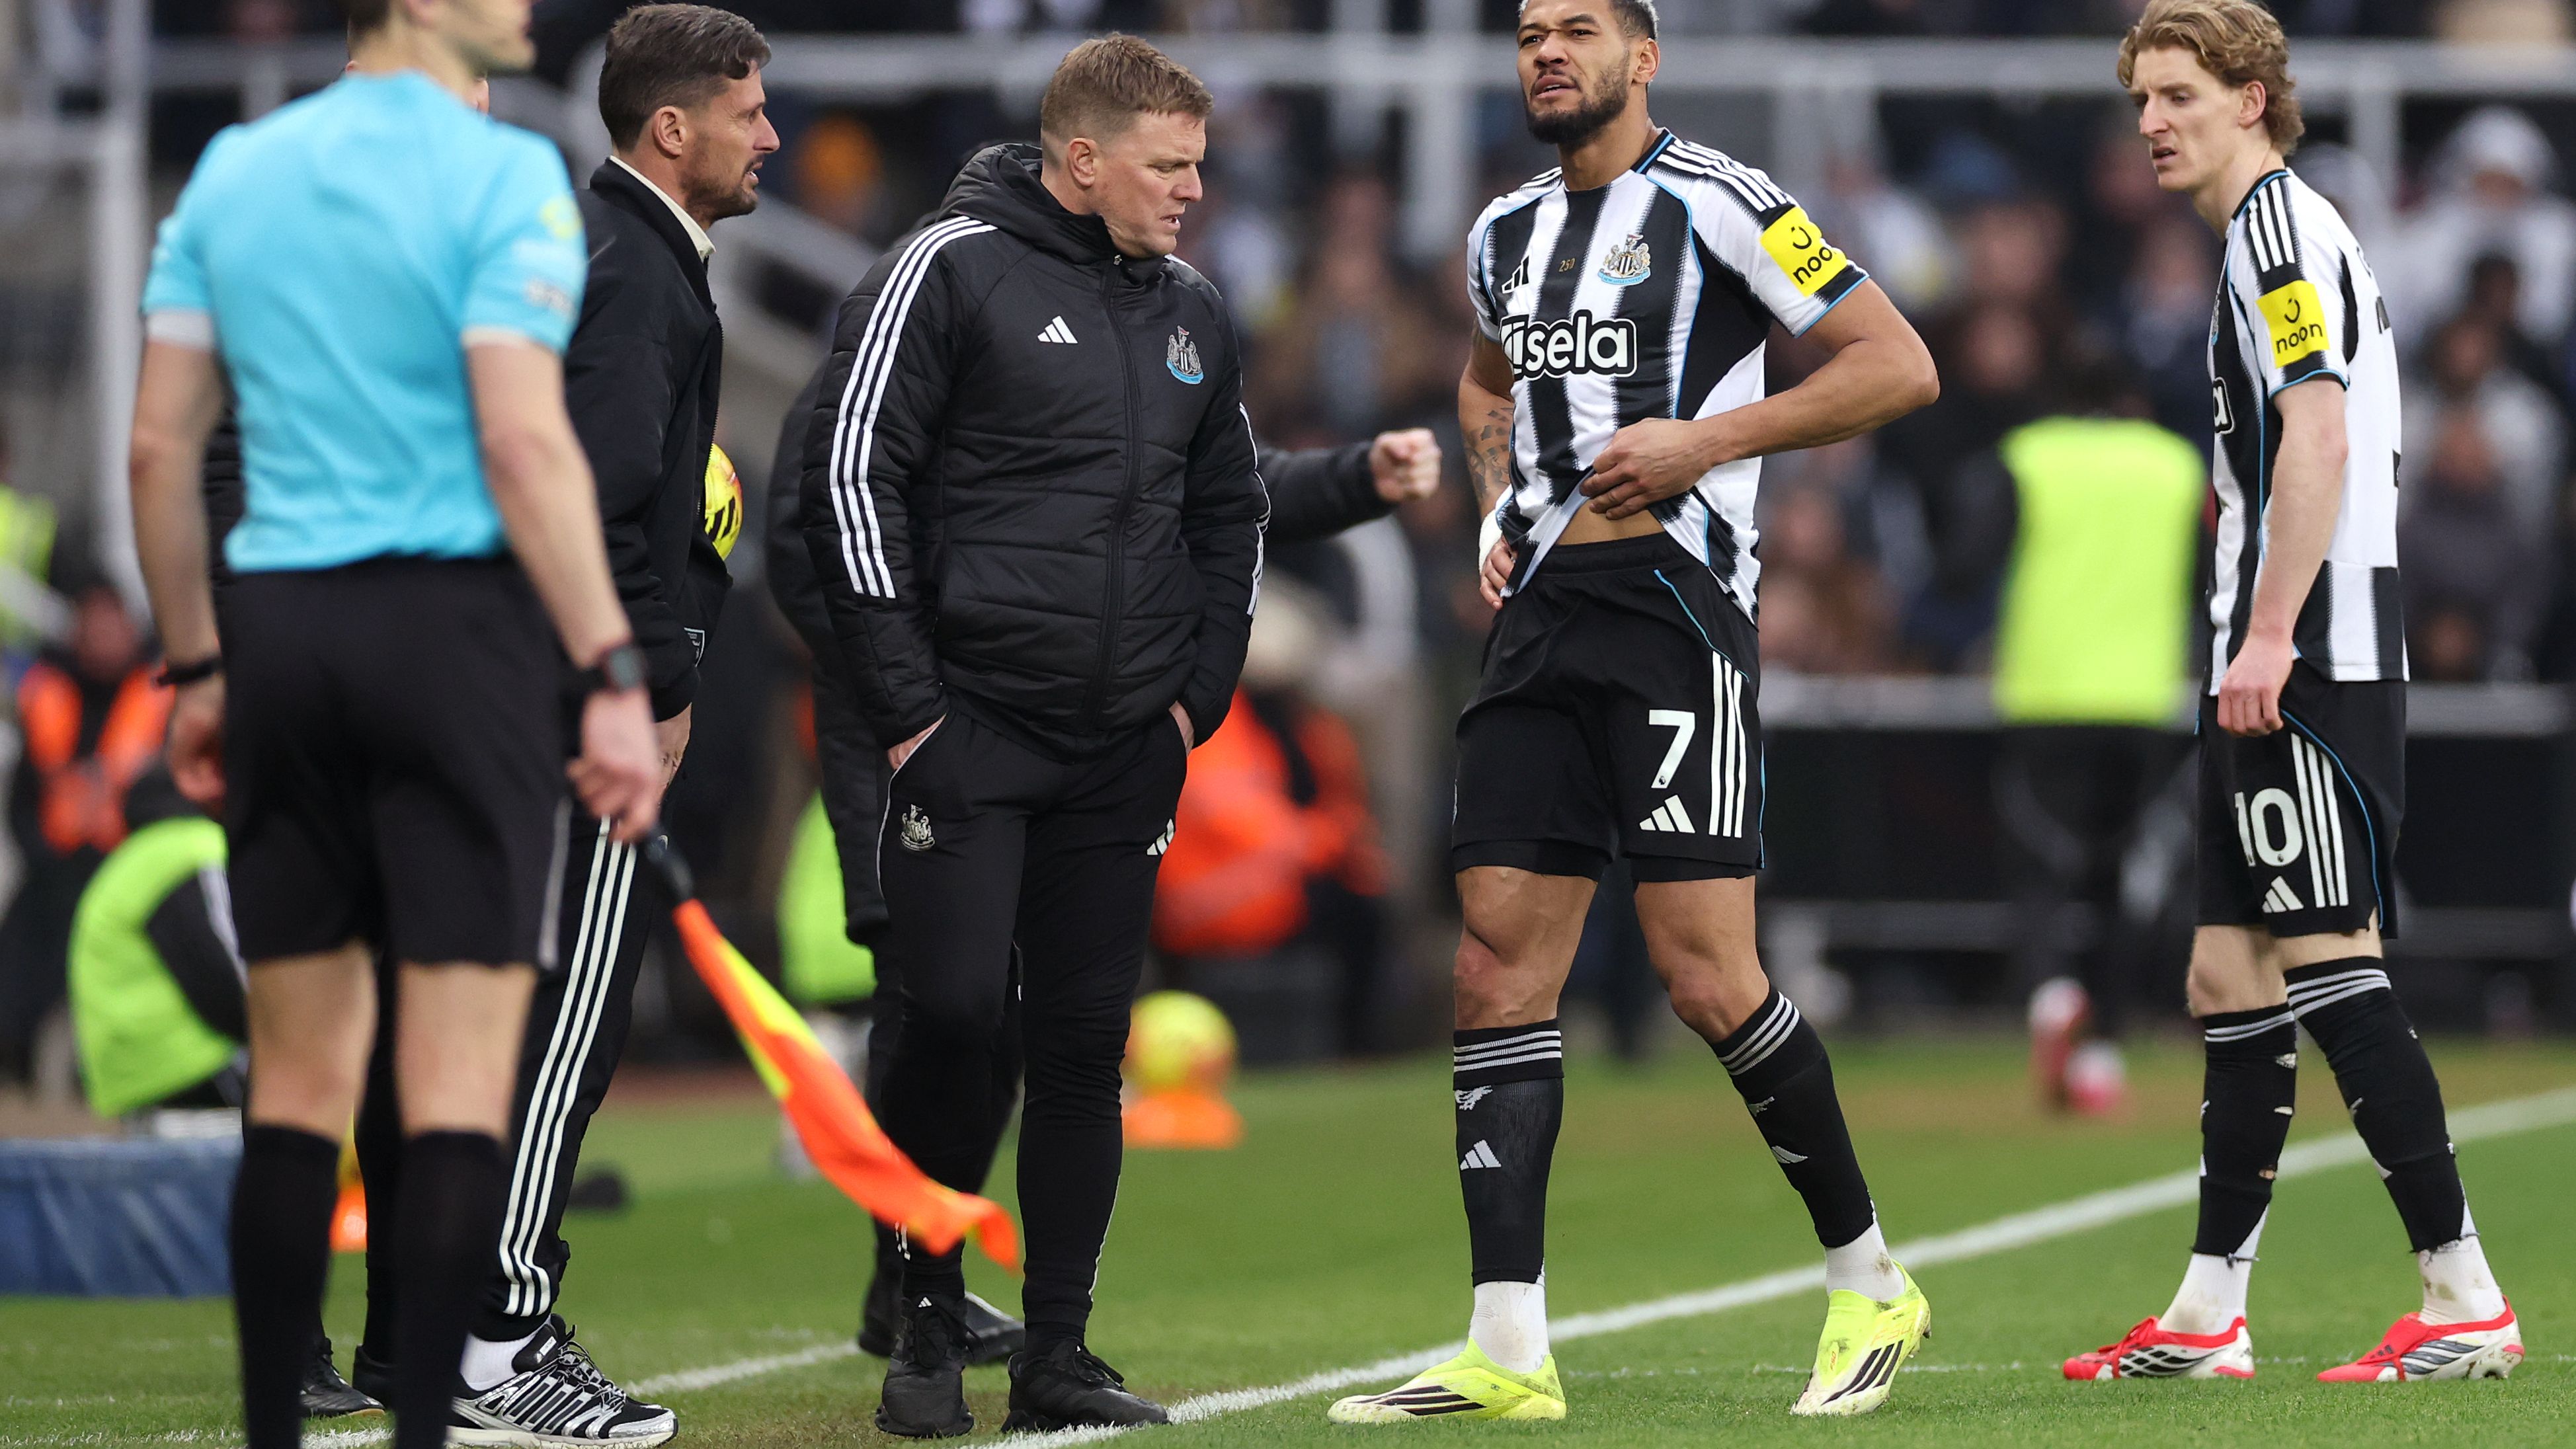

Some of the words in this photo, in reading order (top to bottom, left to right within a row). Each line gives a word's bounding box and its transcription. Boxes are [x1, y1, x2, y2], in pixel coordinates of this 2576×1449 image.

[1792, 247, 1836, 285] noo
[2276, 323, 2323, 354] noon
[1648, 709, 1696, 789] 7
[2234, 787, 2304, 867] 10
